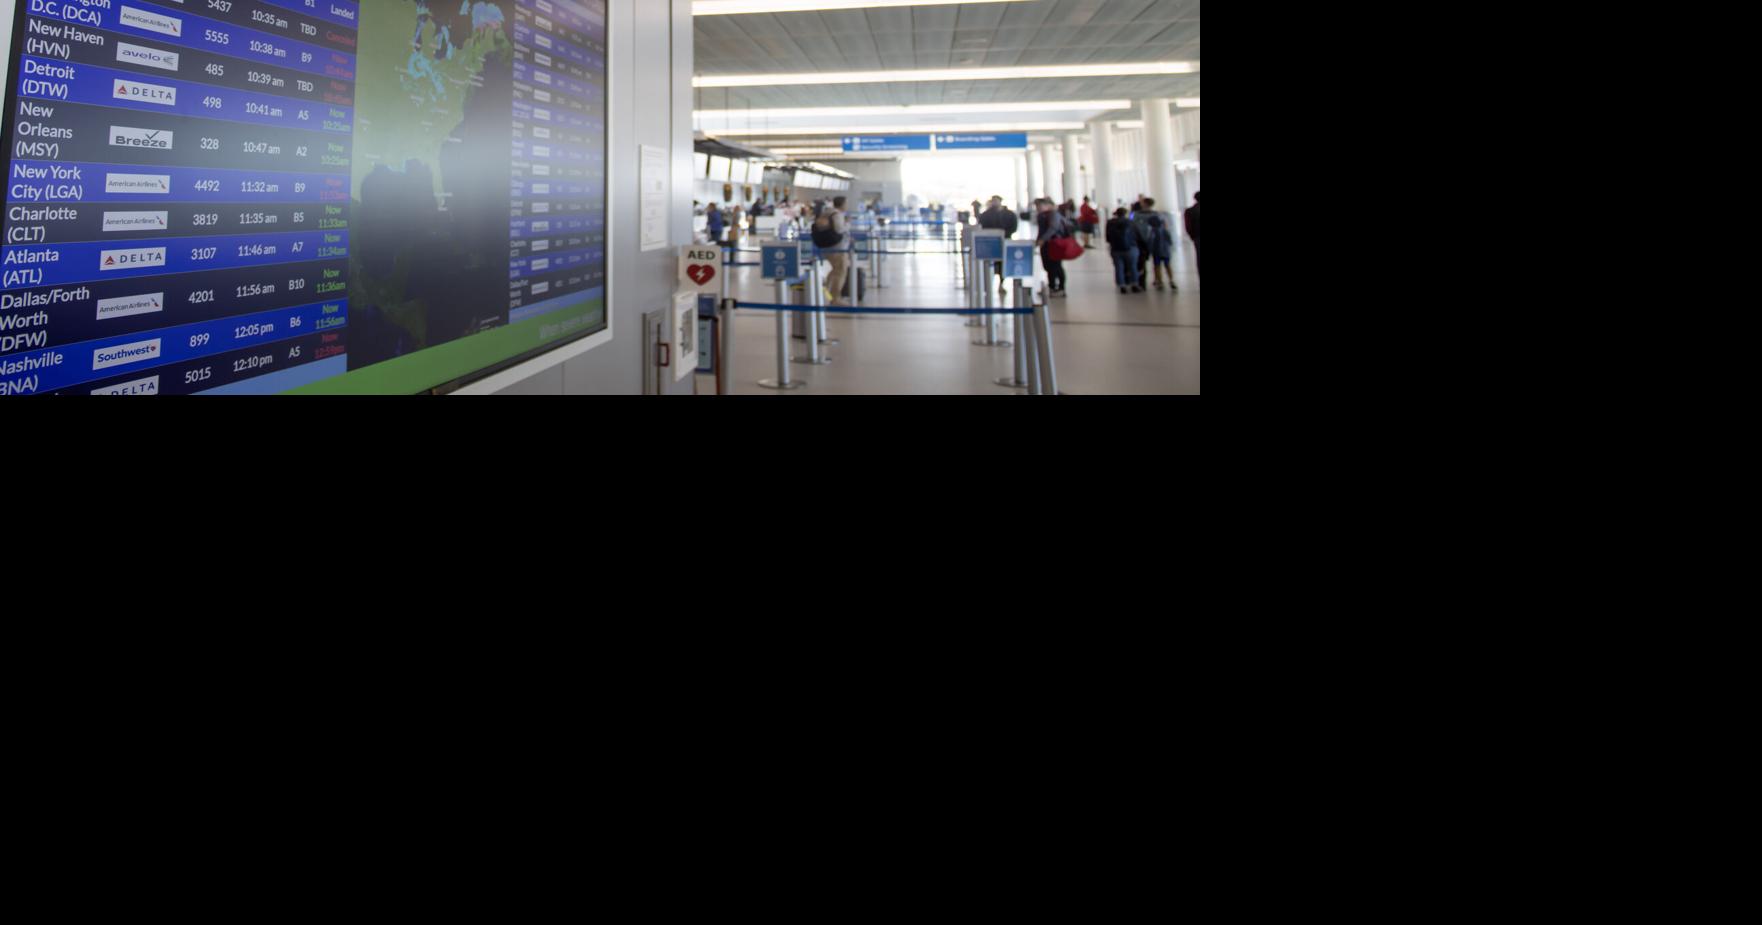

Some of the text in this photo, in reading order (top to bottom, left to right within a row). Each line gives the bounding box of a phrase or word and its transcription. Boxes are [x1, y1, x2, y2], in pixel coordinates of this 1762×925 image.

[31, 0, 59, 16] D.C.
[62, 4, 102, 26] (DCA)
[207, 0, 232, 13] 5437
[330, 4, 354, 20] Landed
[252, 10, 288, 29] 10:35 am
[29, 19, 104, 46] New Haven
[300, 23, 317, 36] TBD
[205, 30, 229, 44] 5555
[27, 38, 70, 60] (HVN)
[250, 40, 286, 58] 10:38 am
[122, 50, 161, 62] avelo
[301, 52, 312, 63] B9
[24, 60, 75, 80] Detroit
[205, 63, 224, 76] 485
[248, 71, 284, 88] 10:39 am
[297, 80, 313, 92] TBD
[22, 78, 68, 100] (DTW)
[132, 86, 172, 100] DELTA
[20, 101, 54, 117] New
[203, 96, 222, 109] 498
[246, 102, 283, 117] 10:41 am
[298, 110, 309, 120] A5
[17, 121, 73, 139] Orleans
[115, 135, 168, 148] Breeze
[200, 137, 219, 150] 328
[16, 141, 59, 159] (MSY)
[243, 142, 280, 155] 10:47 am
[296, 146, 307, 157] A2
[13, 164, 81, 180] New York
[108, 180, 136, 188] American
[194, 180, 220, 192] 4492
[241, 181, 279, 193] 11:32 am
[294, 182, 306, 193] B9
[11, 184, 83, 200] City (LGA)
[9, 206, 78, 221] Charlotte
[325, 205, 342, 215] Now
[105, 218, 134, 226] American
[192, 213, 218, 226] 3819
[239, 213, 277, 224] 11:35 am
[293, 212, 305, 223] B5
[7, 226, 46, 244] (CLT)
[324, 233, 341, 243] Now
[238, 245, 276, 257] 11:46 am
[292, 241, 304, 252] A7
[4, 249, 59, 264] Atlanta
[120, 252, 162, 263] DELTA
[191, 247, 217, 260] 3107
[687, 250, 716, 260] AED
[2, 268, 43, 288] (ATL)
[323, 268, 340, 278] Now
[236, 283, 275, 298] 11:56 am
[288, 278, 305, 291] B10
[1, 286, 90, 309] Dallas/Forth
[188, 290, 214, 303] 4201
[99, 301, 151, 312] American Airlines
[322, 304, 339, 314] Now
[0, 311, 48, 330] Worth
[290, 316, 301, 328] B6
[234, 324, 274, 339] 12:05 pm
[0, 330, 47, 351] DFW)
[189, 333, 210, 347] 899
[97, 346, 150, 362] Southwest
[288, 346, 301, 359] A5
[0, 351, 63, 376] Nashville
[233, 354, 273, 372] 12:10 pm
[185, 366, 211, 384] 5015
[0, 375, 38, 395] BNA)
